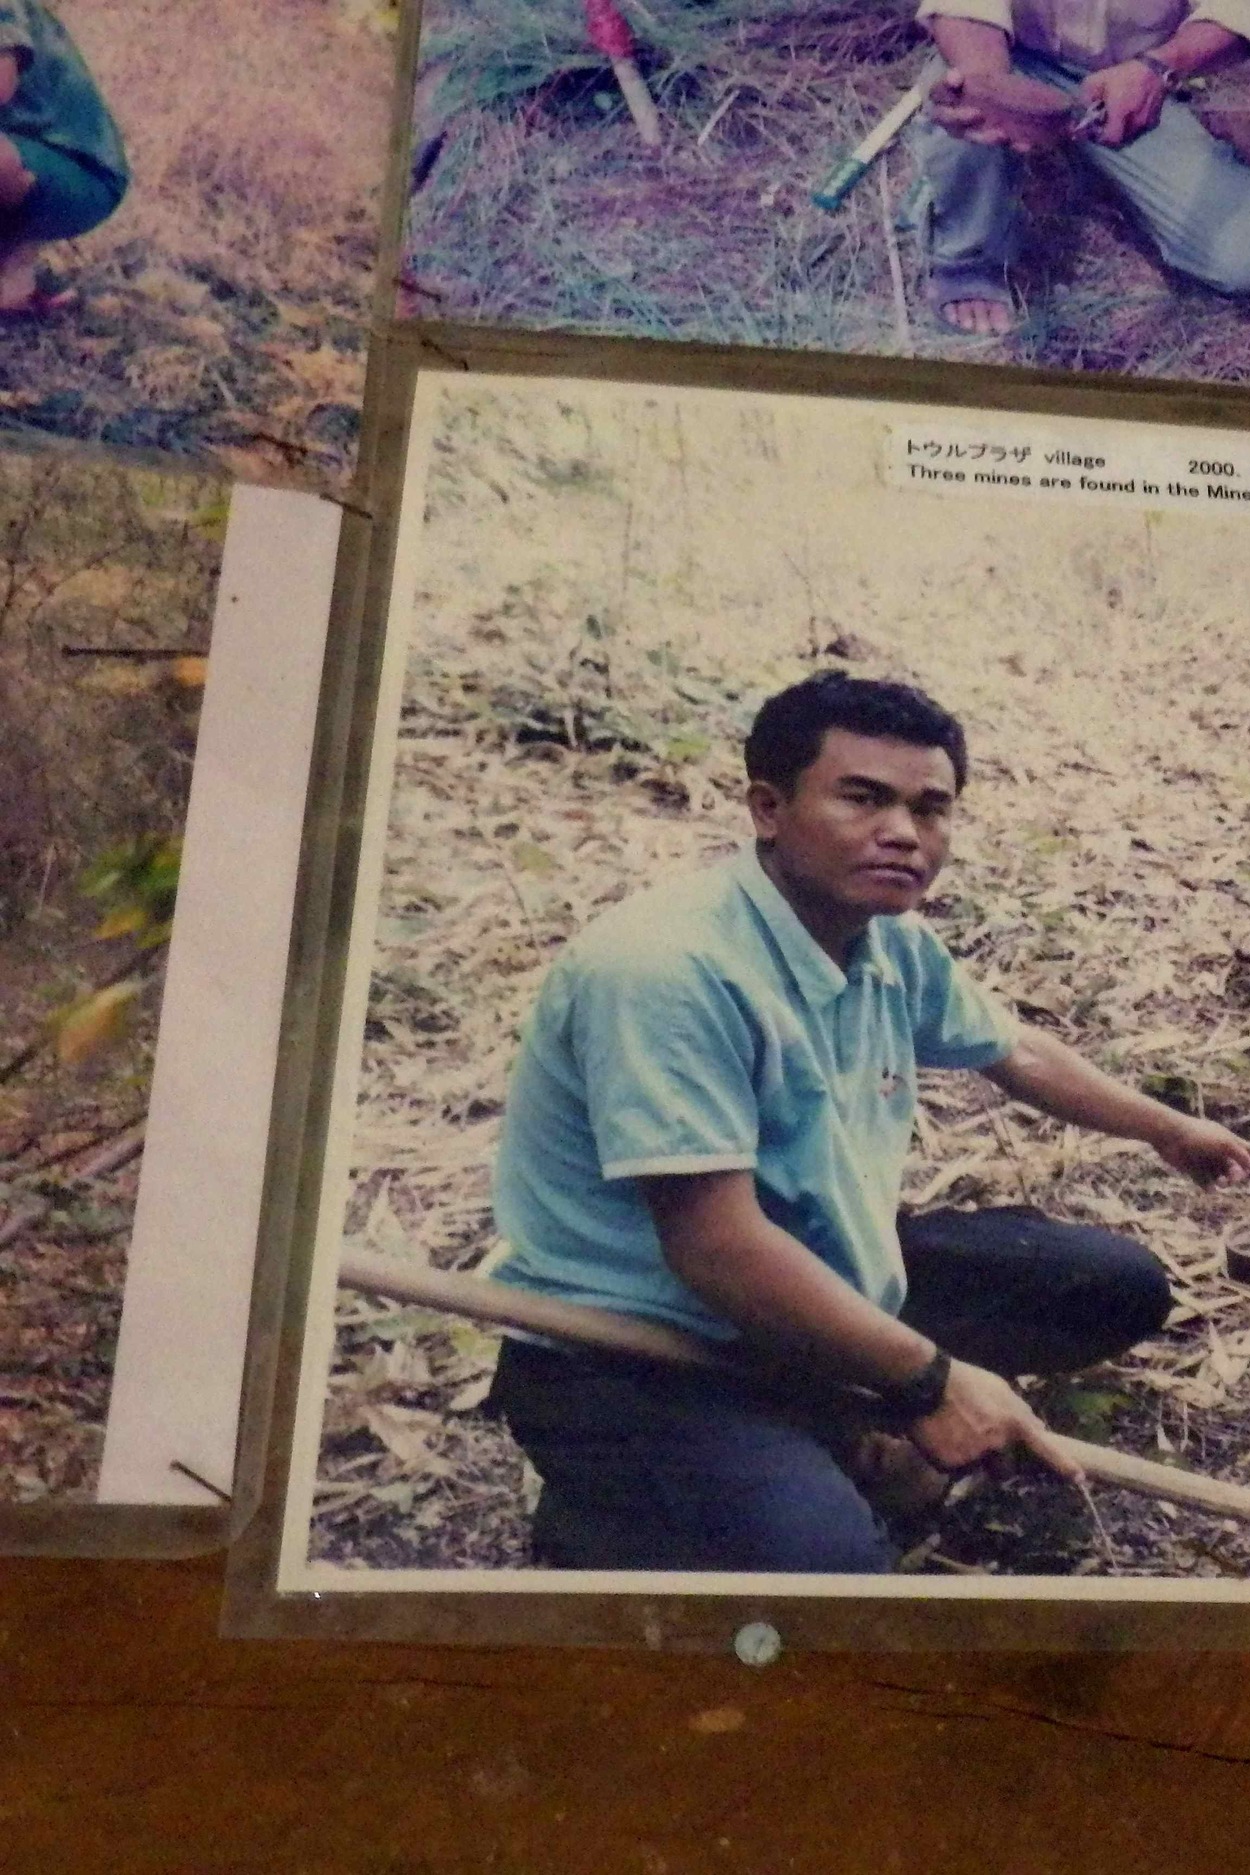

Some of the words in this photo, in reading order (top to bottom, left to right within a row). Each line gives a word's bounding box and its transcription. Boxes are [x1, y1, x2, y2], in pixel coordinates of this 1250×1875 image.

[1044, 449, 1106, 470] village
[908, 463, 967, 483] Three
[974, 469, 1032, 487] mines
[1039, 476, 1073, 490] are
[1079, 476, 1136, 494] found
[1143, 480, 1160, 495] in
[1168, 482, 1200, 498] the
